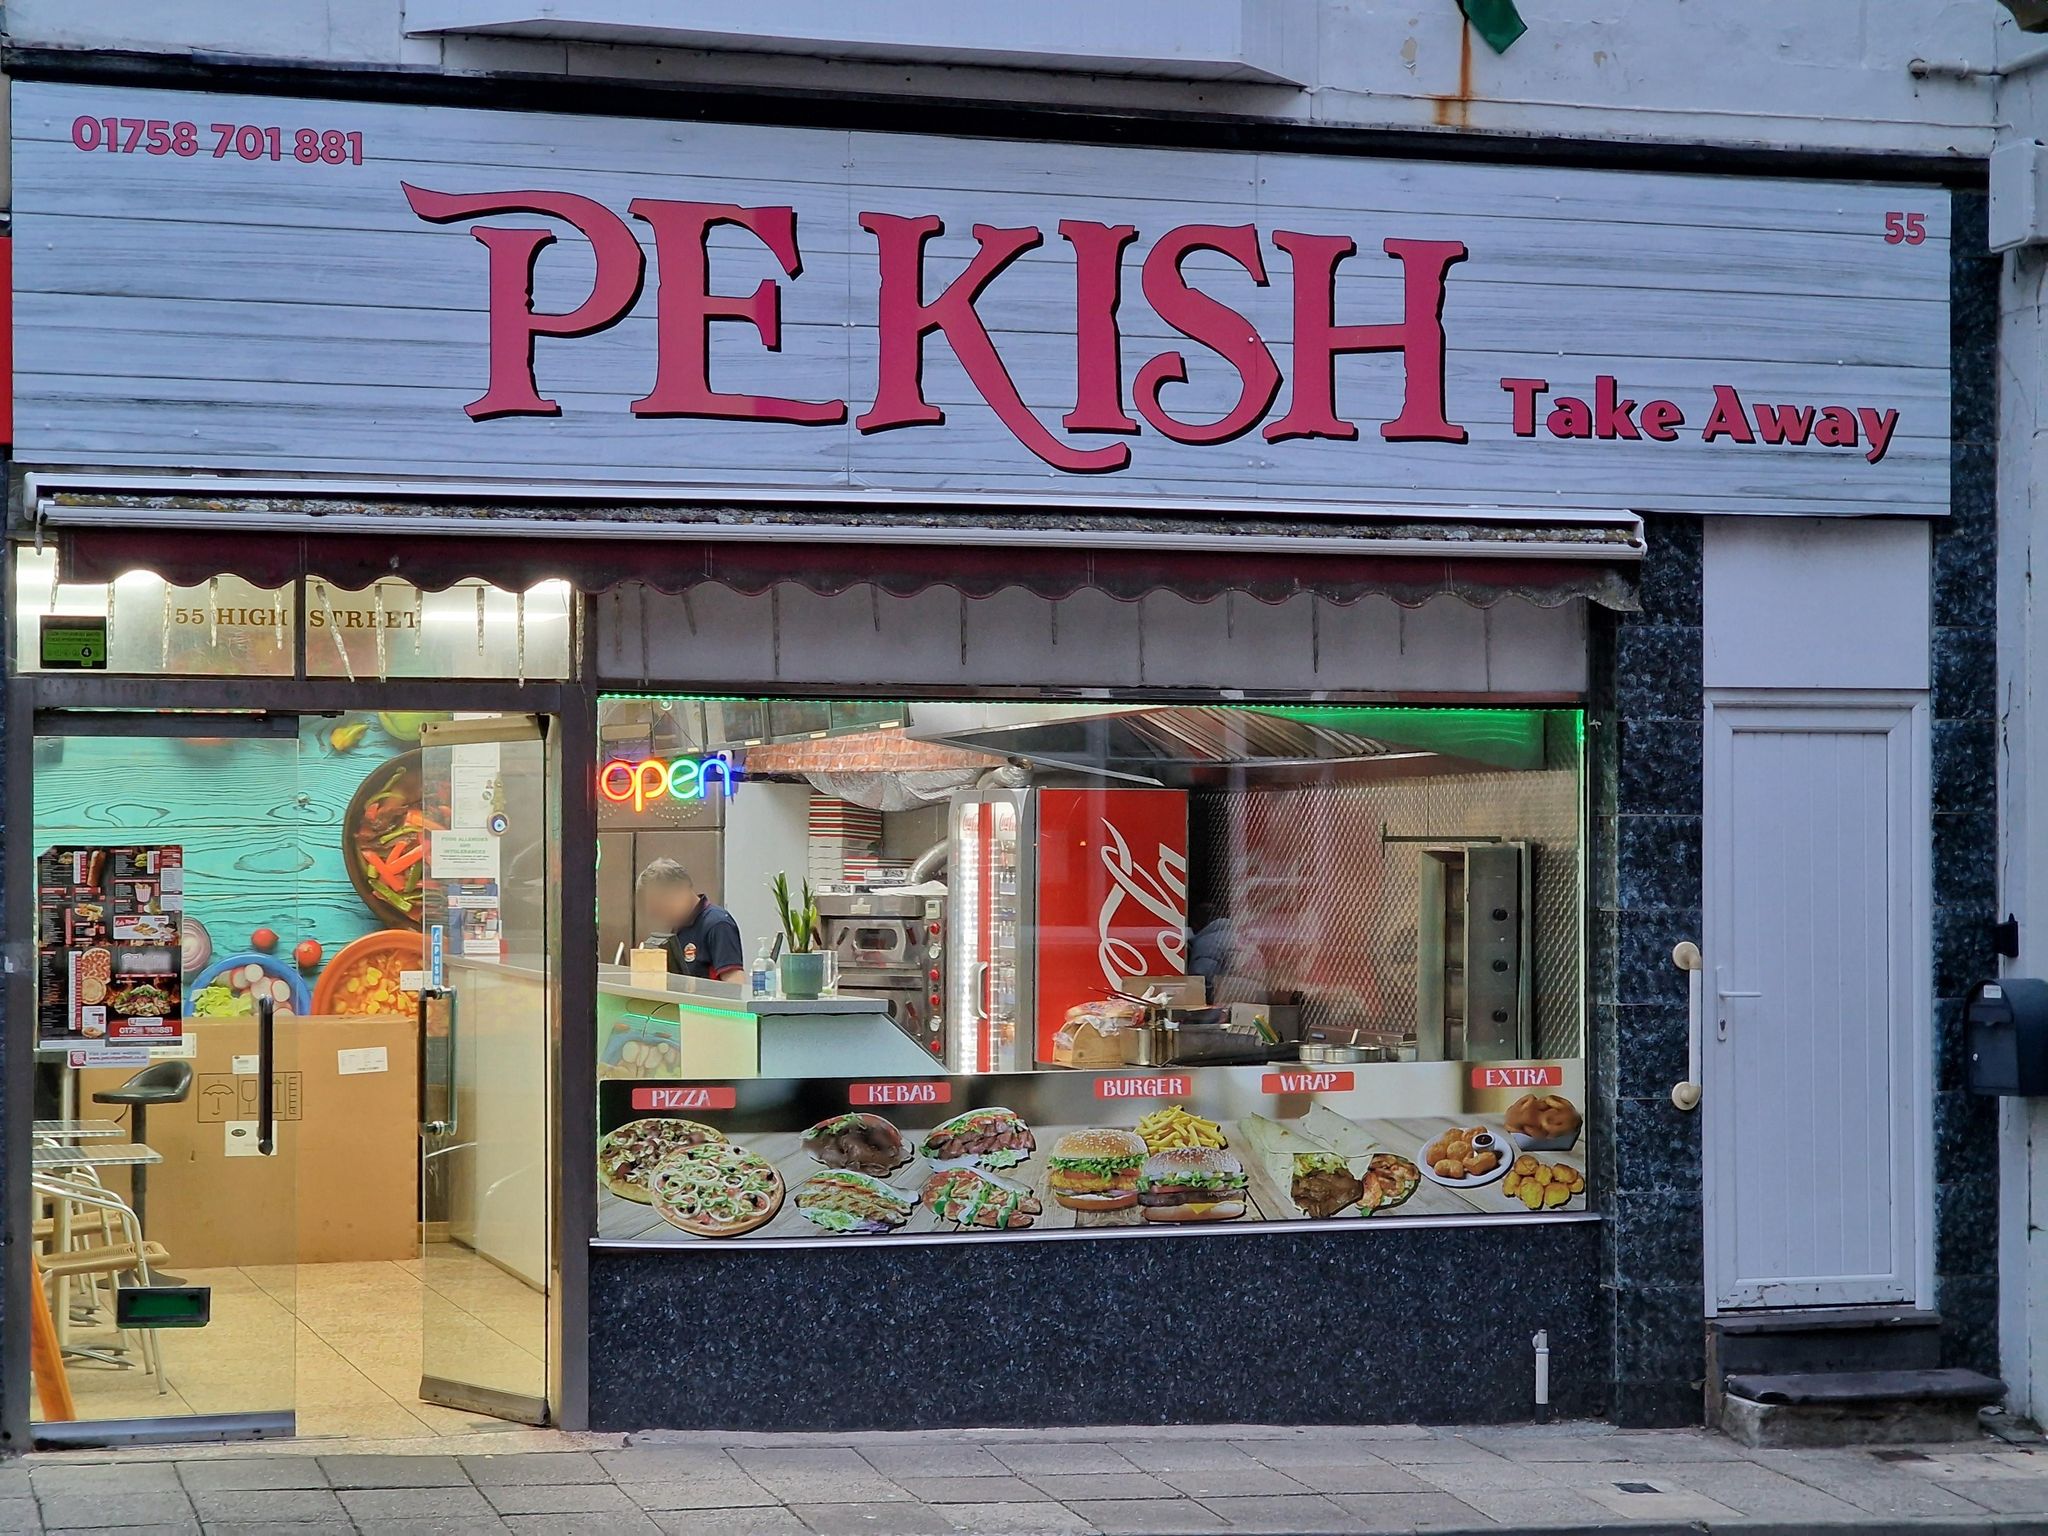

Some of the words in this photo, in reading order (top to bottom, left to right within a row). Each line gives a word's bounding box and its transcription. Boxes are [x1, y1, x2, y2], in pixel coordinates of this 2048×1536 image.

[71, 115, 199, 157] 01758
[211, 124, 282, 162] 701
[293, 129, 364, 165] 881
[1884, 212, 1927, 246] 55
[401, 181, 1469, 473] PEKISH
[1500, 375, 1685, 442] Take
[1702, 384, 1900, 465] Away
[175, 608, 205, 625] 55
[216, 608, 288, 626] HIGH
[309, 609, 418, 629] STREET
[600, 758, 731, 813] open
[433, 945, 442, 986] PUSH
[1103, 1078, 1184, 1097] BURGER
[1280, 1072, 1338, 1092] WRAP
[1486, 1068, 1549, 1087] EXTRA
[651, 1089, 711, 1108] PIZZA
[868, 1082, 936, 1103] KEBAB
